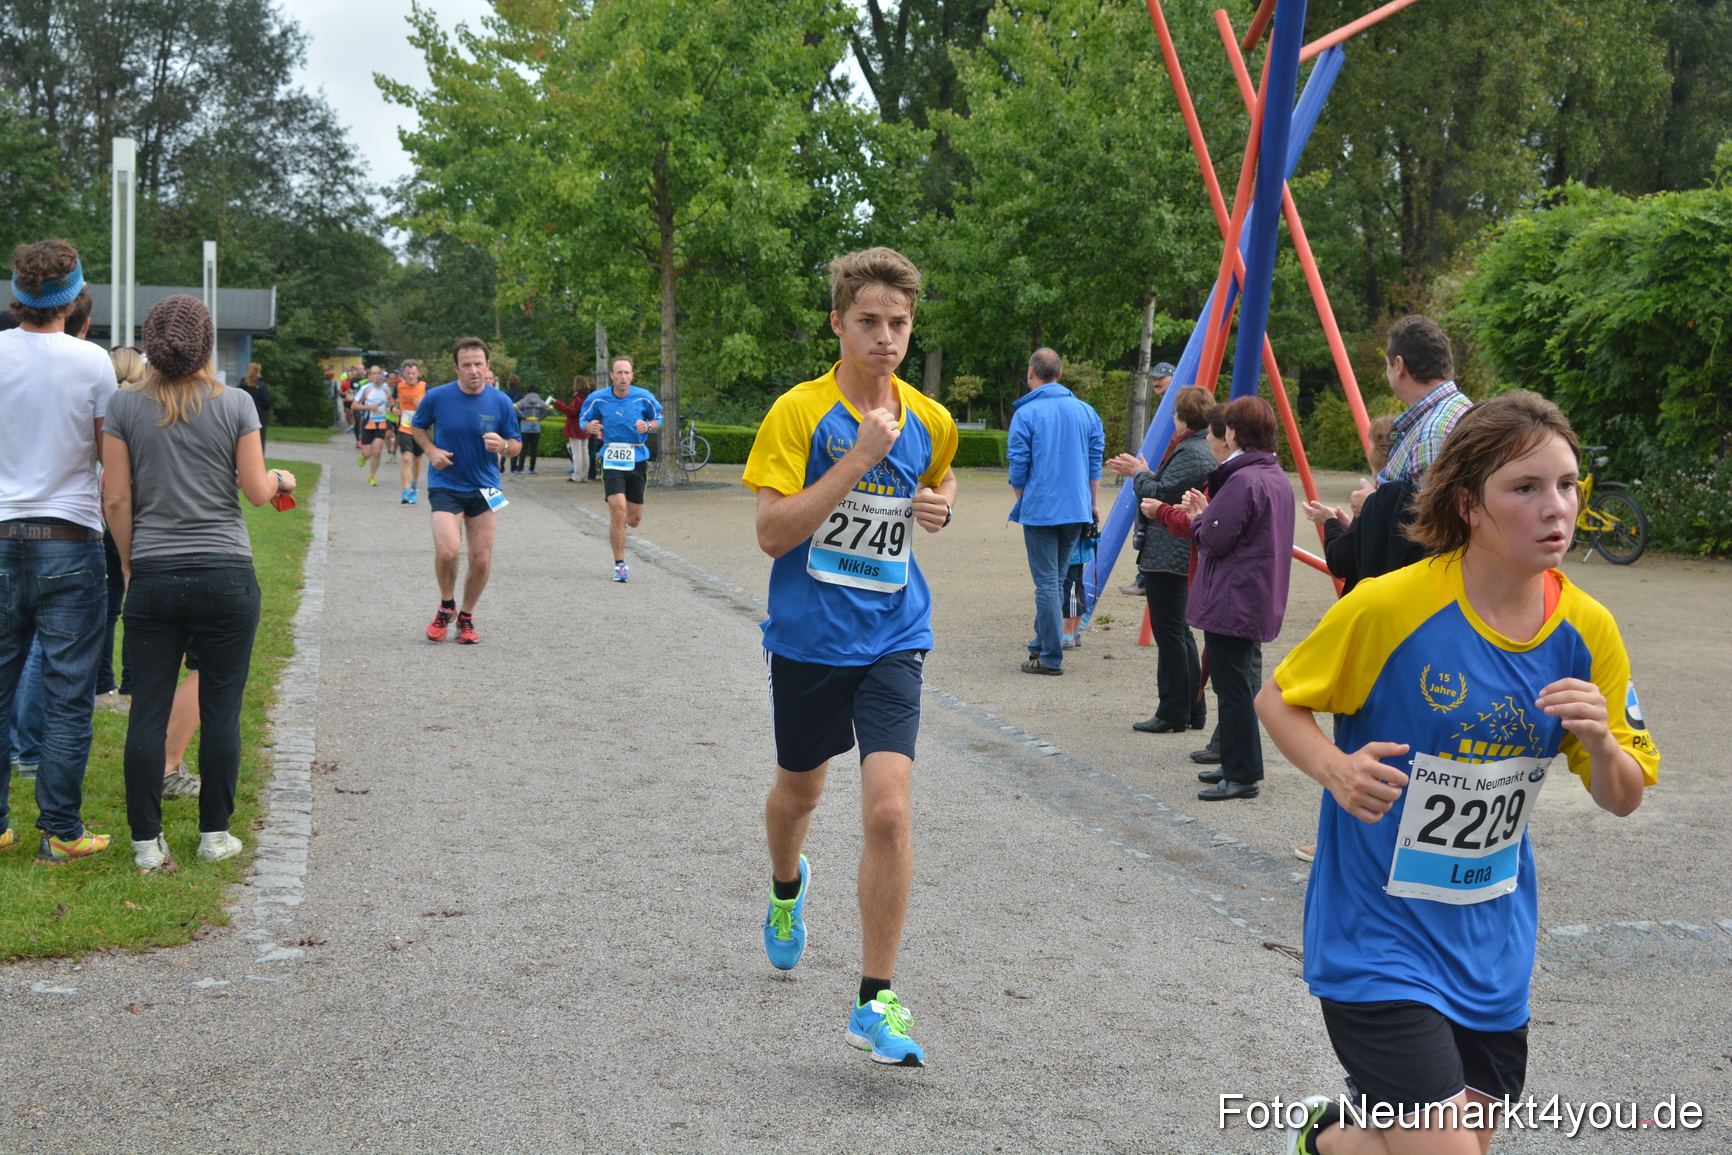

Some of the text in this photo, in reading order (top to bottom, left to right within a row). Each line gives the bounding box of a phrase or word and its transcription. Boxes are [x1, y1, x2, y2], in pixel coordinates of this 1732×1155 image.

[607, 449, 632, 460] 2462
[838, 499, 902, 517] RTL Neumarkt
[823, 512, 905, 557] 2749
[838, 557, 880, 577] Niklas
[1438, 672, 1451, 682] 15
[1429, 683, 1457, 697] Jahre
[1415, 768, 1525, 791] PARTL Neumarkt
[1416, 788, 1526, 850] 2229
[1451, 864, 1492, 885] Lena
